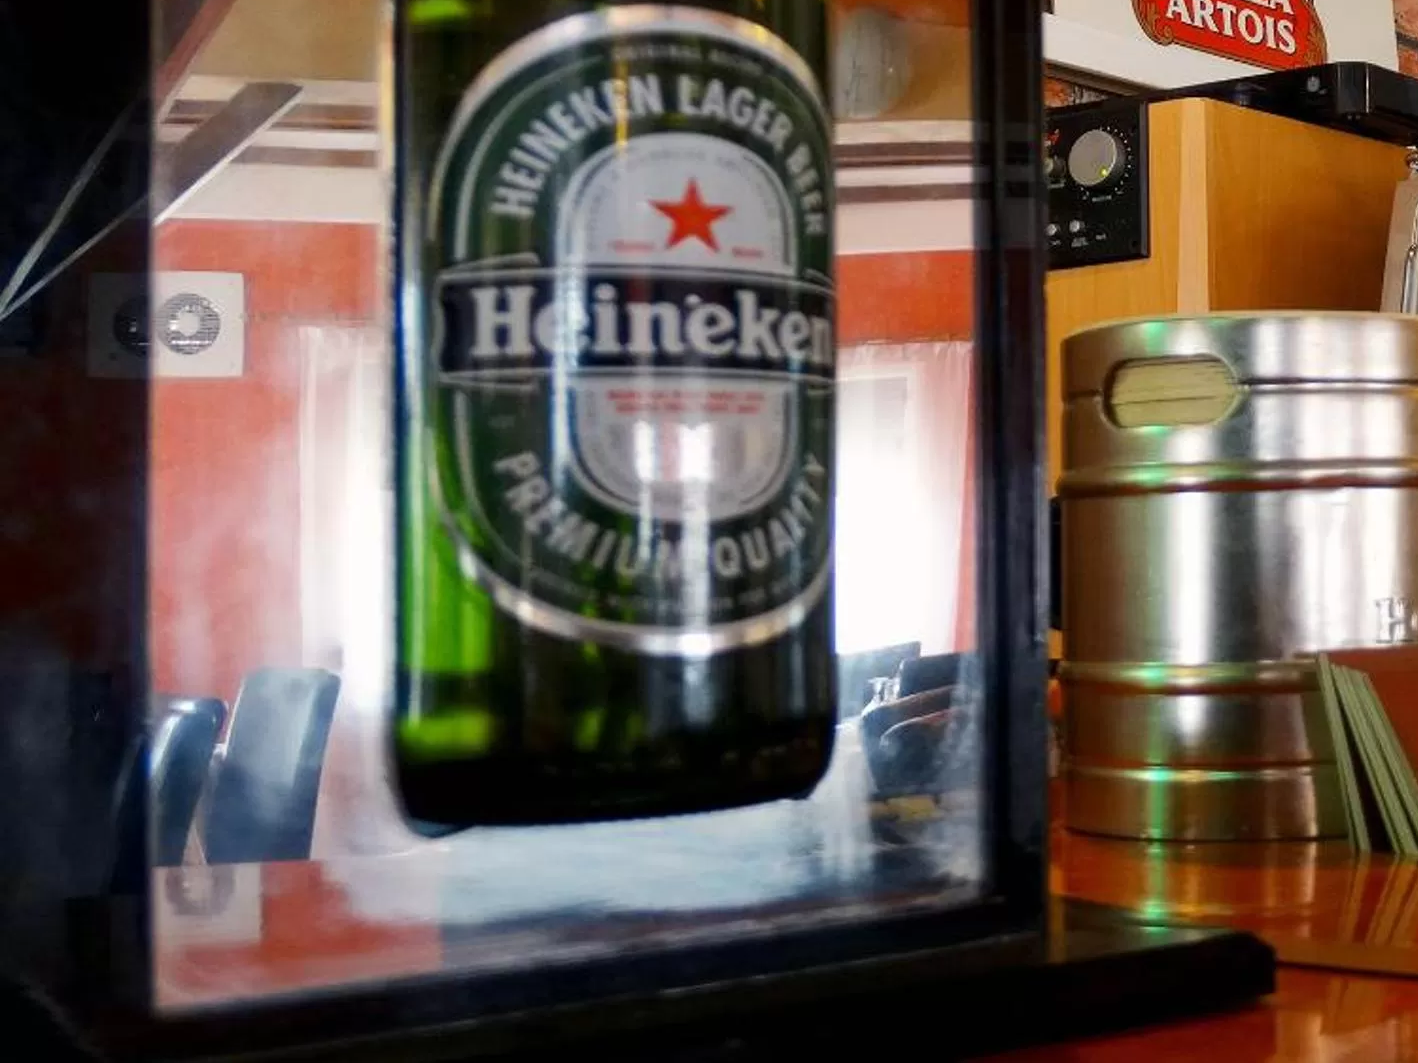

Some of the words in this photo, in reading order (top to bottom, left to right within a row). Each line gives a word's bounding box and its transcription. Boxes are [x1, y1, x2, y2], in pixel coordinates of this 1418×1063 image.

[490, 73, 664, 218] HEINEKEN
[676, 72, 793, 152] LAGER
[469, 283, 833, 365] Heineken
[713, 453, 825, 579] QUALITY
